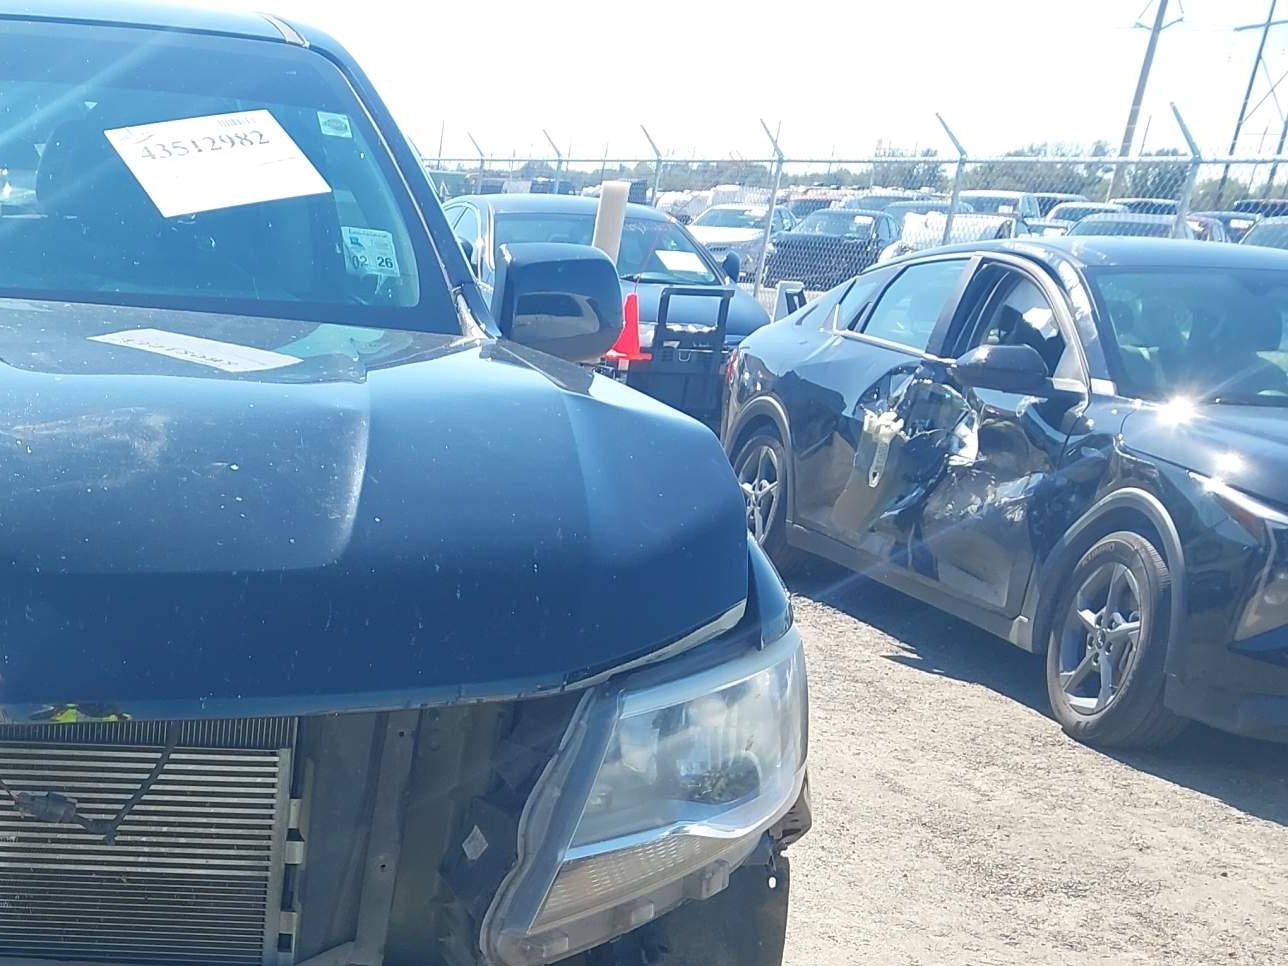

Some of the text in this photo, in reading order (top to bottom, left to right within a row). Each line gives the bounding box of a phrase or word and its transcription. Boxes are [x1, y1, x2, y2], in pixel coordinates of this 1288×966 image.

[140, 129, 270, 160] 43512982
[352, 255, 393, 270] 02 26
